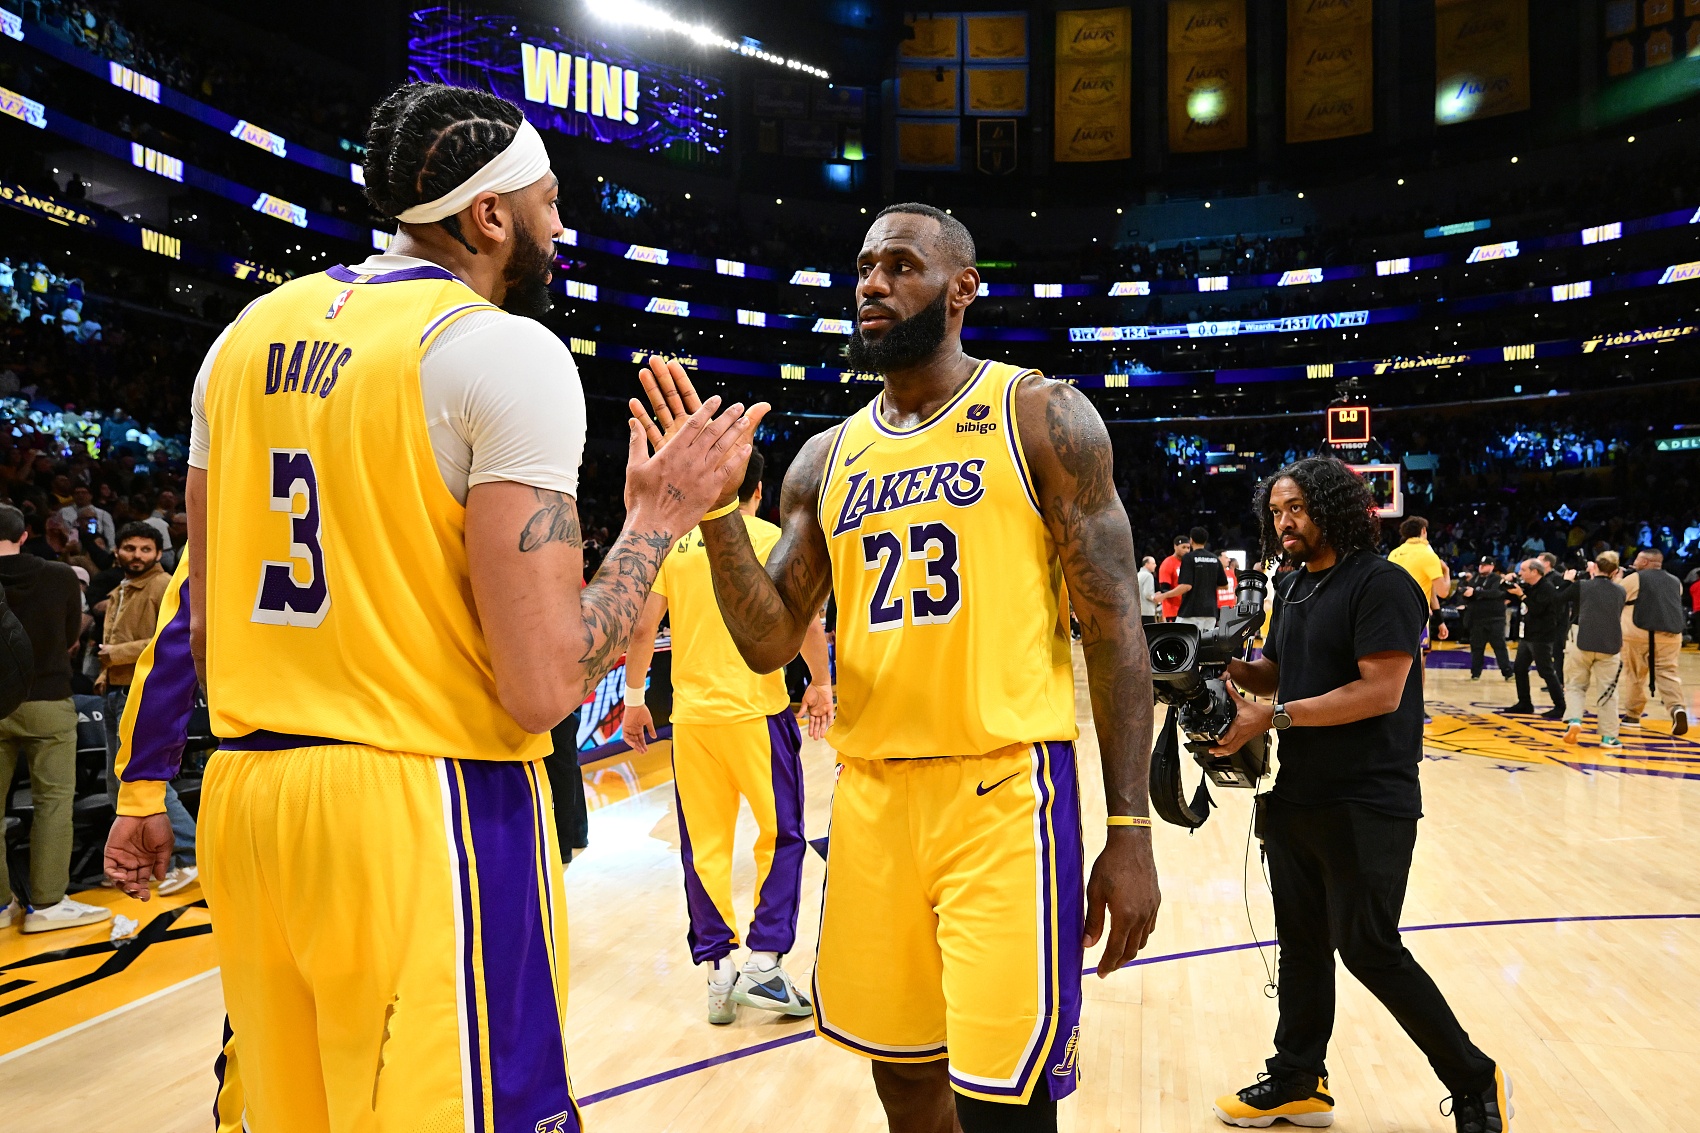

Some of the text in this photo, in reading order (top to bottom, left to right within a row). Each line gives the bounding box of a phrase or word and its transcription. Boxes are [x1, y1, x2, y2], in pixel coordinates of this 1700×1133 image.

[110, 61, 160, 103] WIN!
[521, 43, 639, 125] WIN!
[131, 142, 183, 182] WIN!
[1582, 222, 1622, 245] WIN!
[141, 228, 181, 260] WIN!
[716, 259, 745, 277] WIN!
[1376, 258, 1410, 276] WIN!
[566, 280, 598, 301] WIN!
[1198, 276, 1228, 292] WIN!
[1552, 280, 1592, 301] WIN!
[737, 309, 766, 327] WIN!
[1244, 319, 1307, 331] Wizards 131
[1123, 328, 1145, 338] 134
[1198, 324, 1218, 335] 0.0
[570, 337, 596, 357] WIN!
[1503, 344, 1535, 362] WIN!
[265, 340, 352, 399] DAVIS
[780, 364, 806, 381] WIN!
[1306, 364, 1334, 379] WIN!
[1104, 374, 1129, 388] WIN!
[1339, 410, 1358, 423] 0.0
[956, 422, 997, 434] bibigo
[1340, 442, 1367, 450] TISSOT
[1671, 439, 1700, 449] DEL
[831, 458, 988, 540] LAKERS
[250, 447, 332, 629] 3
[860, 519, 962, 633] 23
